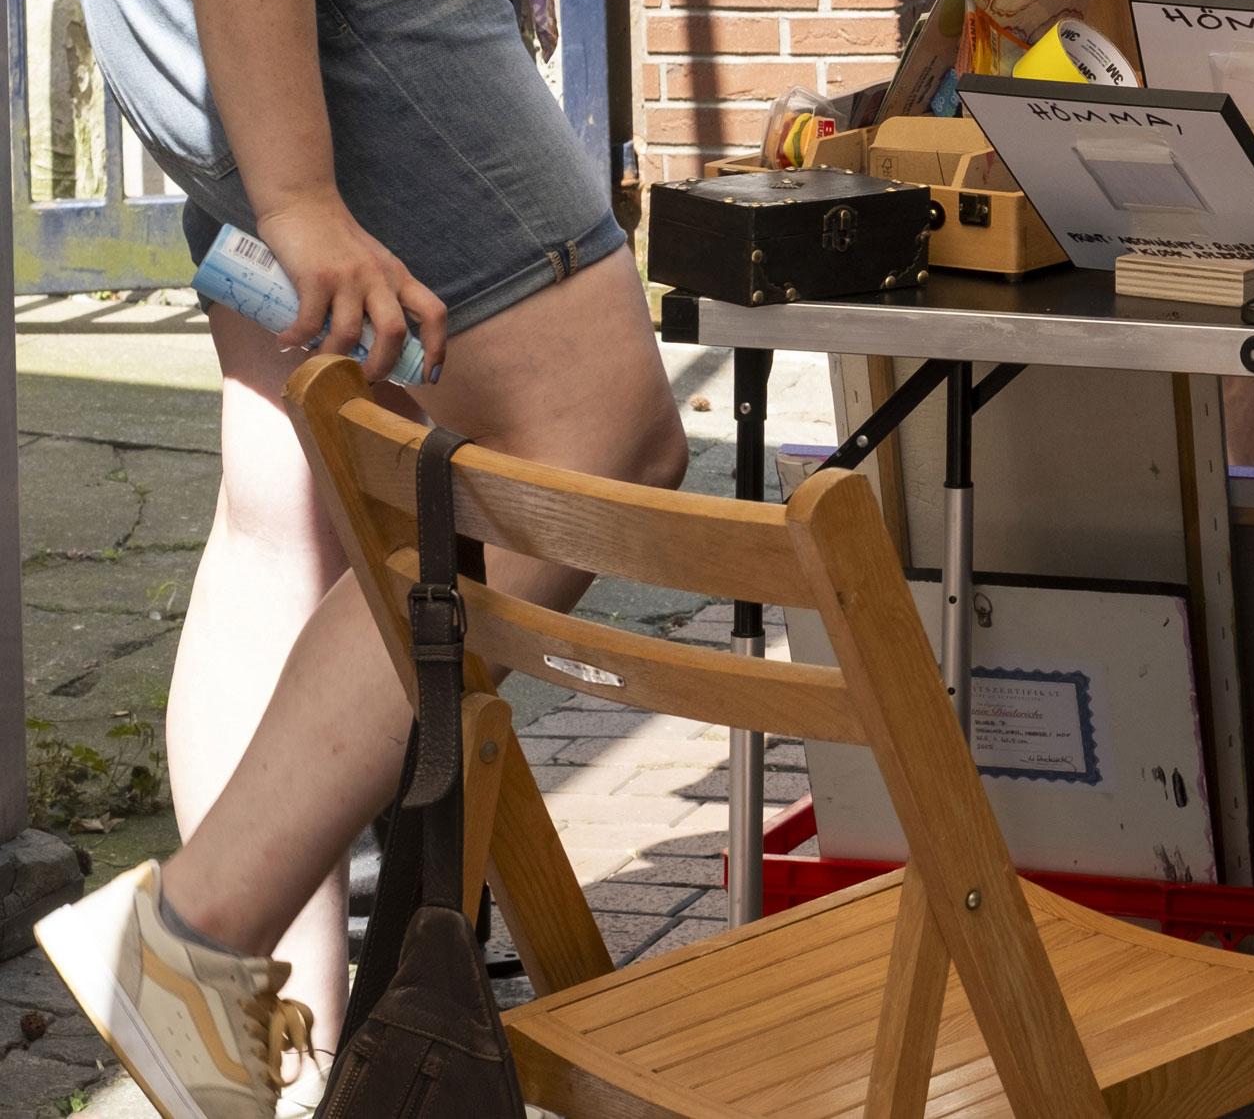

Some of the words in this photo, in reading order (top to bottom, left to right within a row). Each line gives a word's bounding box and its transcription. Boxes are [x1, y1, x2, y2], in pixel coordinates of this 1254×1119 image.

[1061, 29, 1081, 42] 3M
[1106, 62, 1124, 86] 3M
[1027, 100, 1184, 136] HÖMMA,
